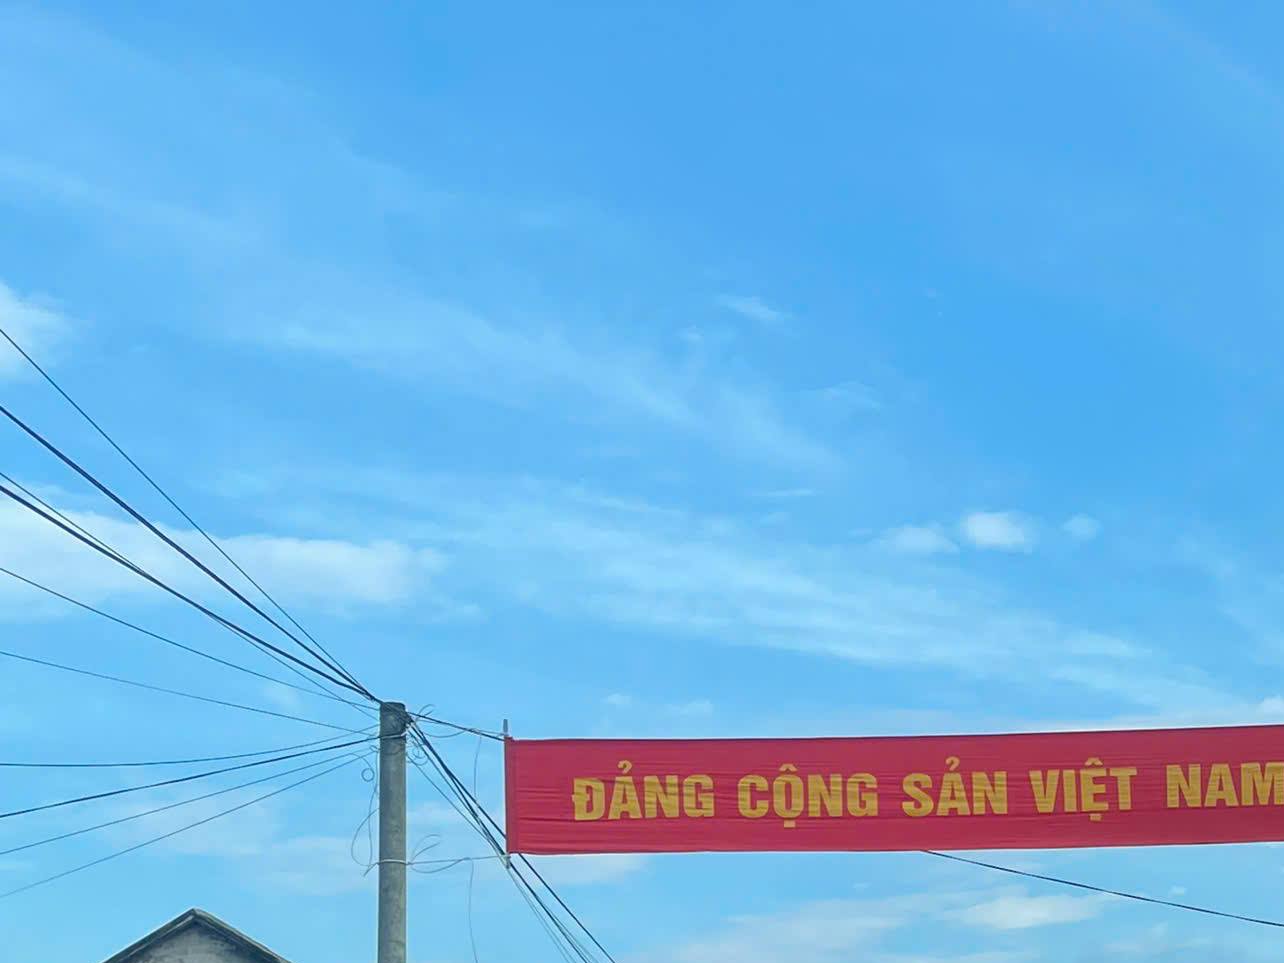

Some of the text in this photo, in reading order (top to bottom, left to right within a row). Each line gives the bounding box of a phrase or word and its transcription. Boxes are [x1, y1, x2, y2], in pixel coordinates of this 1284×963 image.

[572, 761, 715, 821] ĐẢNG
[738, 764, 879, 828] CỘNG
[901, 757, 1008, 817] SẢN
[1029, 757, 1137, 821] VIỆT
